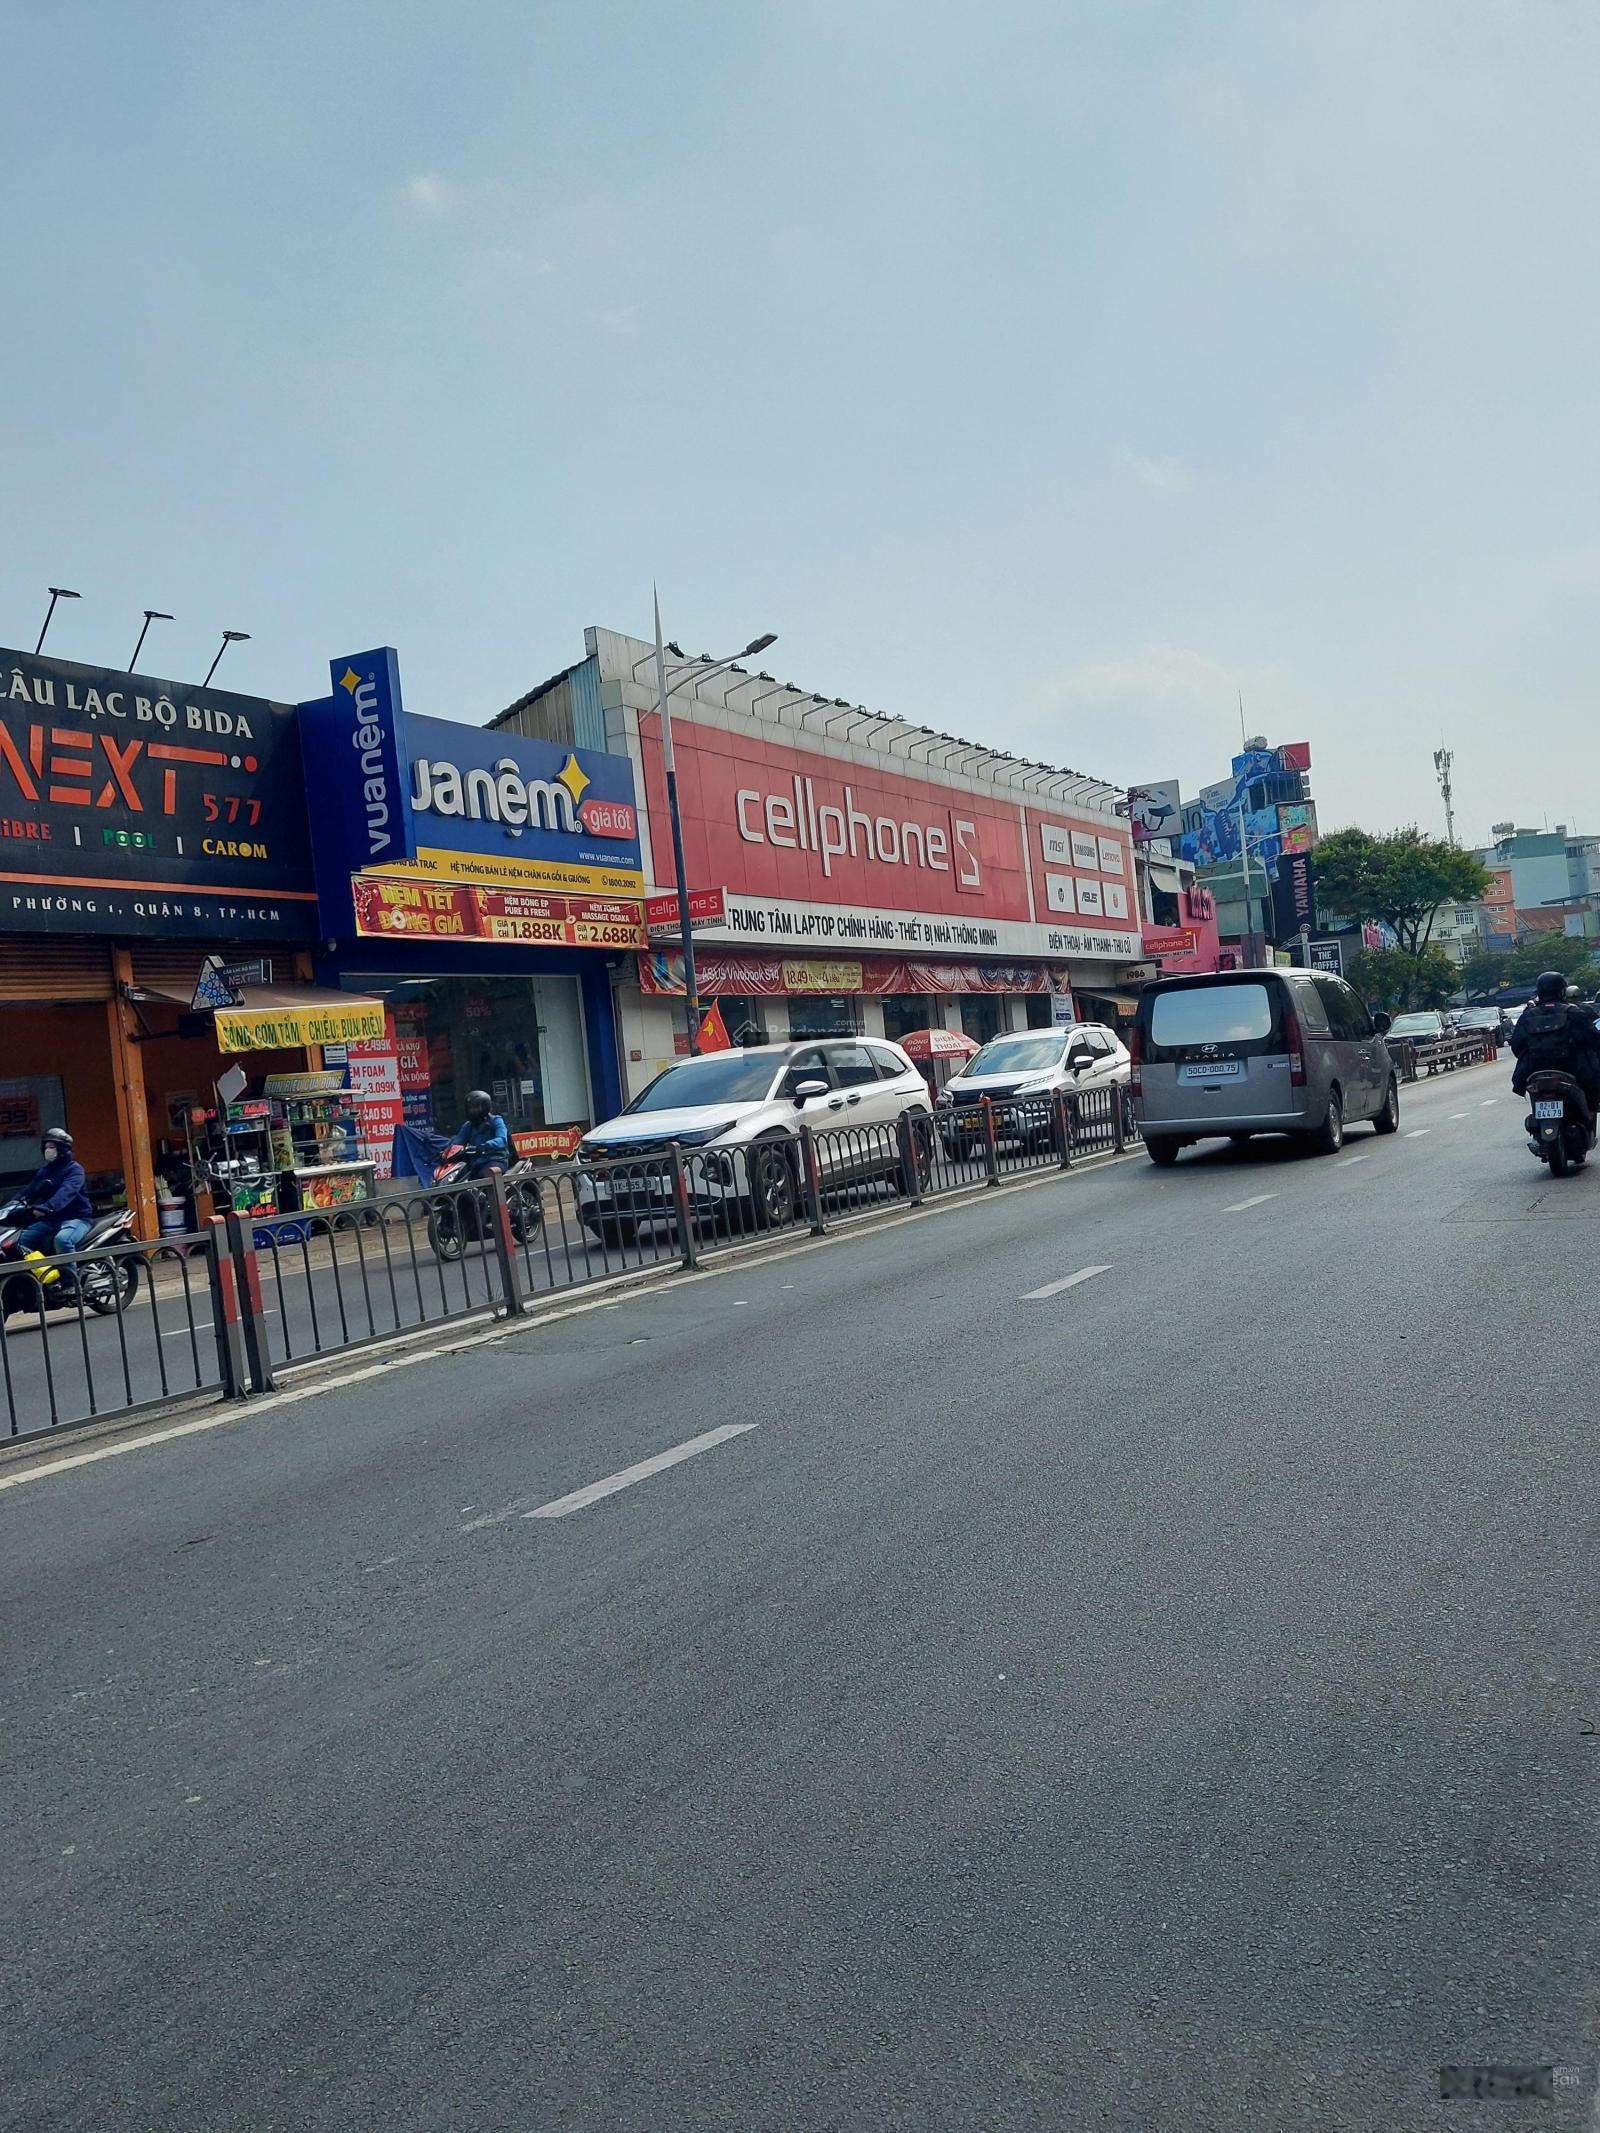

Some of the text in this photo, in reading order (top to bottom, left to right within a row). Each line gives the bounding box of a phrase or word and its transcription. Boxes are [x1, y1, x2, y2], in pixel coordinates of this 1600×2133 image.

[66, 683, 127, 719] LẠC
[135, 695, 177, 731] BỘ
[186, 706, 253, 738] BIDA
[0, 720, 228, 815] NEXT
[352, 682, 391, 855] vuanệm
[203, 793, 261, 826] 577
[590, 806, 632, 831] giá tốt
[736, 775, 949, 877] cellphone
[102, 828, 157, 849] POOL
[202, 838, 268, 859] CAROM
[1049, 839, 1065, 853] msi
[578, 850, 635, 865] www.vuanem.com
[450, 861, 460, 874] HỆ
[461, 861, 484, 874] THỐNG
[485, 865, 499, 875] BÁN
[509, 867, 523, 879] NỆM
[542, 871, 551, 880] GA
[1081, 891, 1098, 904] ASUS
[1292, 858, 1309, 918] YAMAHA
[423, 886, 454, 910] TẾT
[12, 896, 97, 912] PHƯỜNG
[134, 902, 183, 918] QUẬN
[218, 907, 280, 921] TP.HCM
[504, 906, 523, 915] PURE
[530, 908, 551, 917] FRESH
[581, 911, 630, 922] MASSAGE OSAKA
[377, 904, 465, 934] ĐỒNG GIÁ
[707, 917, 723, 925] TÍNH
[768, 908, 793, 935] TÂM
[795, 913, 834, 937] LAPTOP
[837, 914, 867, 938] CHÍNH
[868, 915, 894, 940] HÃNG
[898, 916, 922, 942] THIẾT
[924, 923, 934, 946] BỊ
[934, 921, 951, 943] NHÀ
[951, 923, 978, 945] THÔNG
[978, 927, 998, 946] MINH
[510, 921, 563, 940] 1.888K
[589, 925, 638, 943] 2.688K
[1048, 930, 1063, 953] ĐIỆN
[1063, 934, 1081, 954] THOẠI
[1092, 936, 1111, 953] THANH
[1145, 937, 1183, 952] cellphone
[1318, 950, 1332, 960] THE
[727, 966, 763, 981] Vivobook
[1312, 960, 1340, 970] COFFEE
[1126, 970, 1146, 980] 1986
[255, 1020, 278, 1045] CƠM
[278, 1014, 300, 1043] TẤM
[308, 1009, 383, 1041] CHIỀU: BÚN RIÊU
[400, 1052, 419, 1069] GIÁ
[362, 1065, 386, 1077] FOAM
[368, 1081, 396, 1094] 3.099K
[381, 1106, 393, 1119] SU
